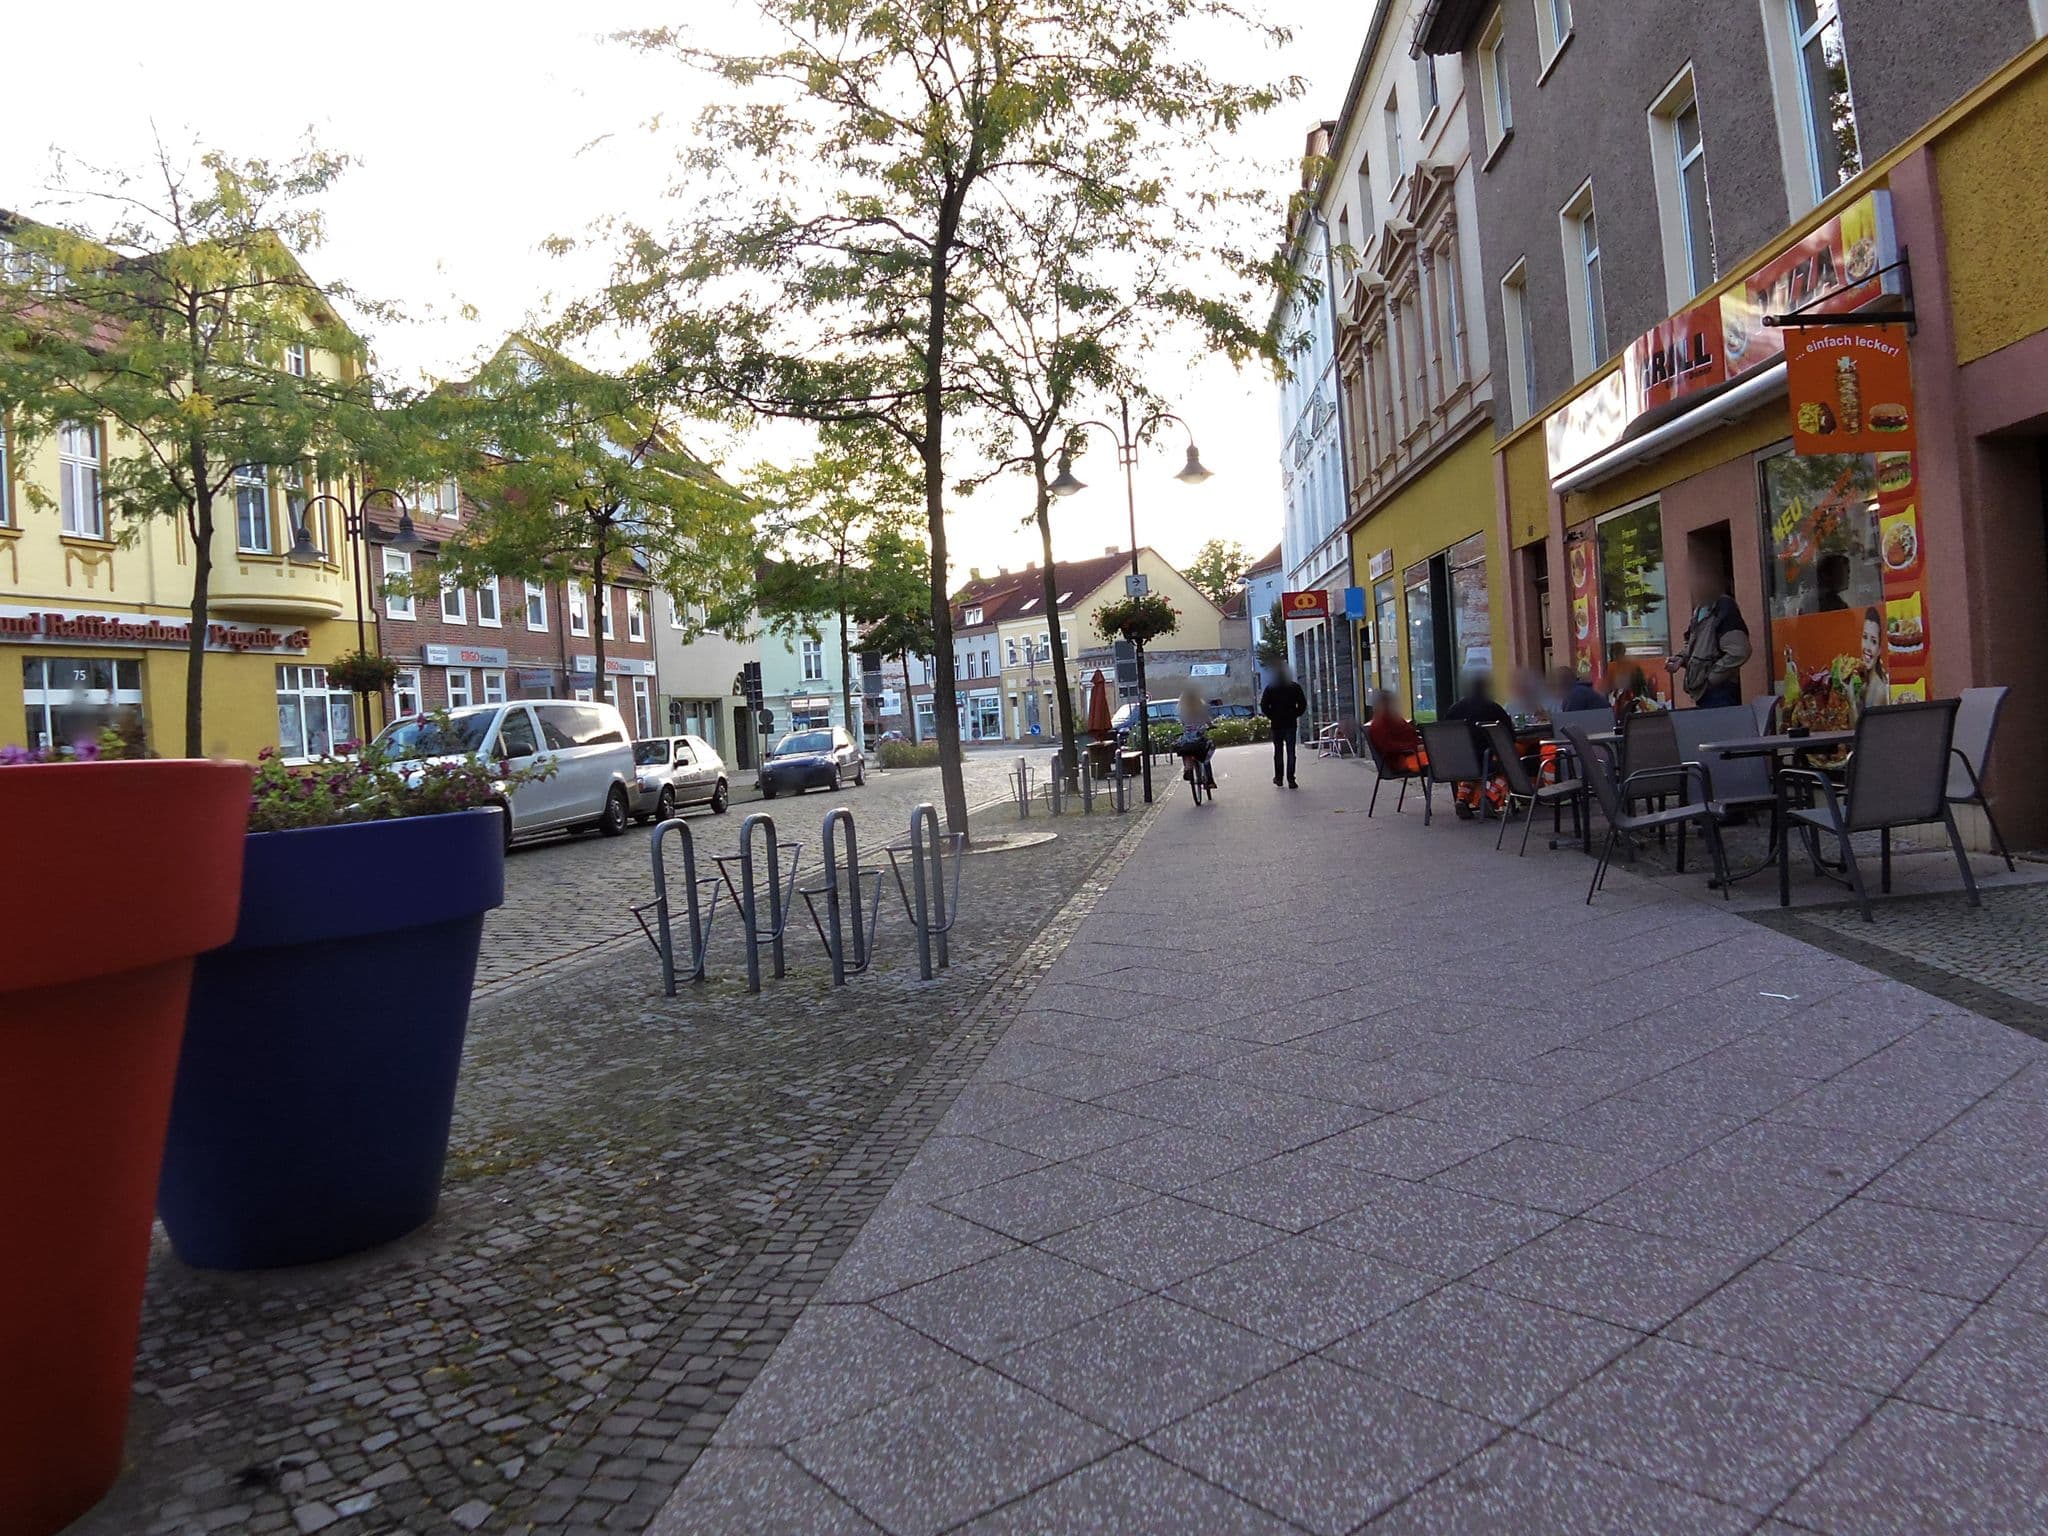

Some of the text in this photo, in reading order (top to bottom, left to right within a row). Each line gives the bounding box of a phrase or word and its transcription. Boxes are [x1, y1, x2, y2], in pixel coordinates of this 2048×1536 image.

[1855, 336, 1901, 358] lecker!
[1772, 496, 1802, 544] NEU
[44, 612, 193, 643] Raiffeisenban
[73, 670, 86, 681] 75
